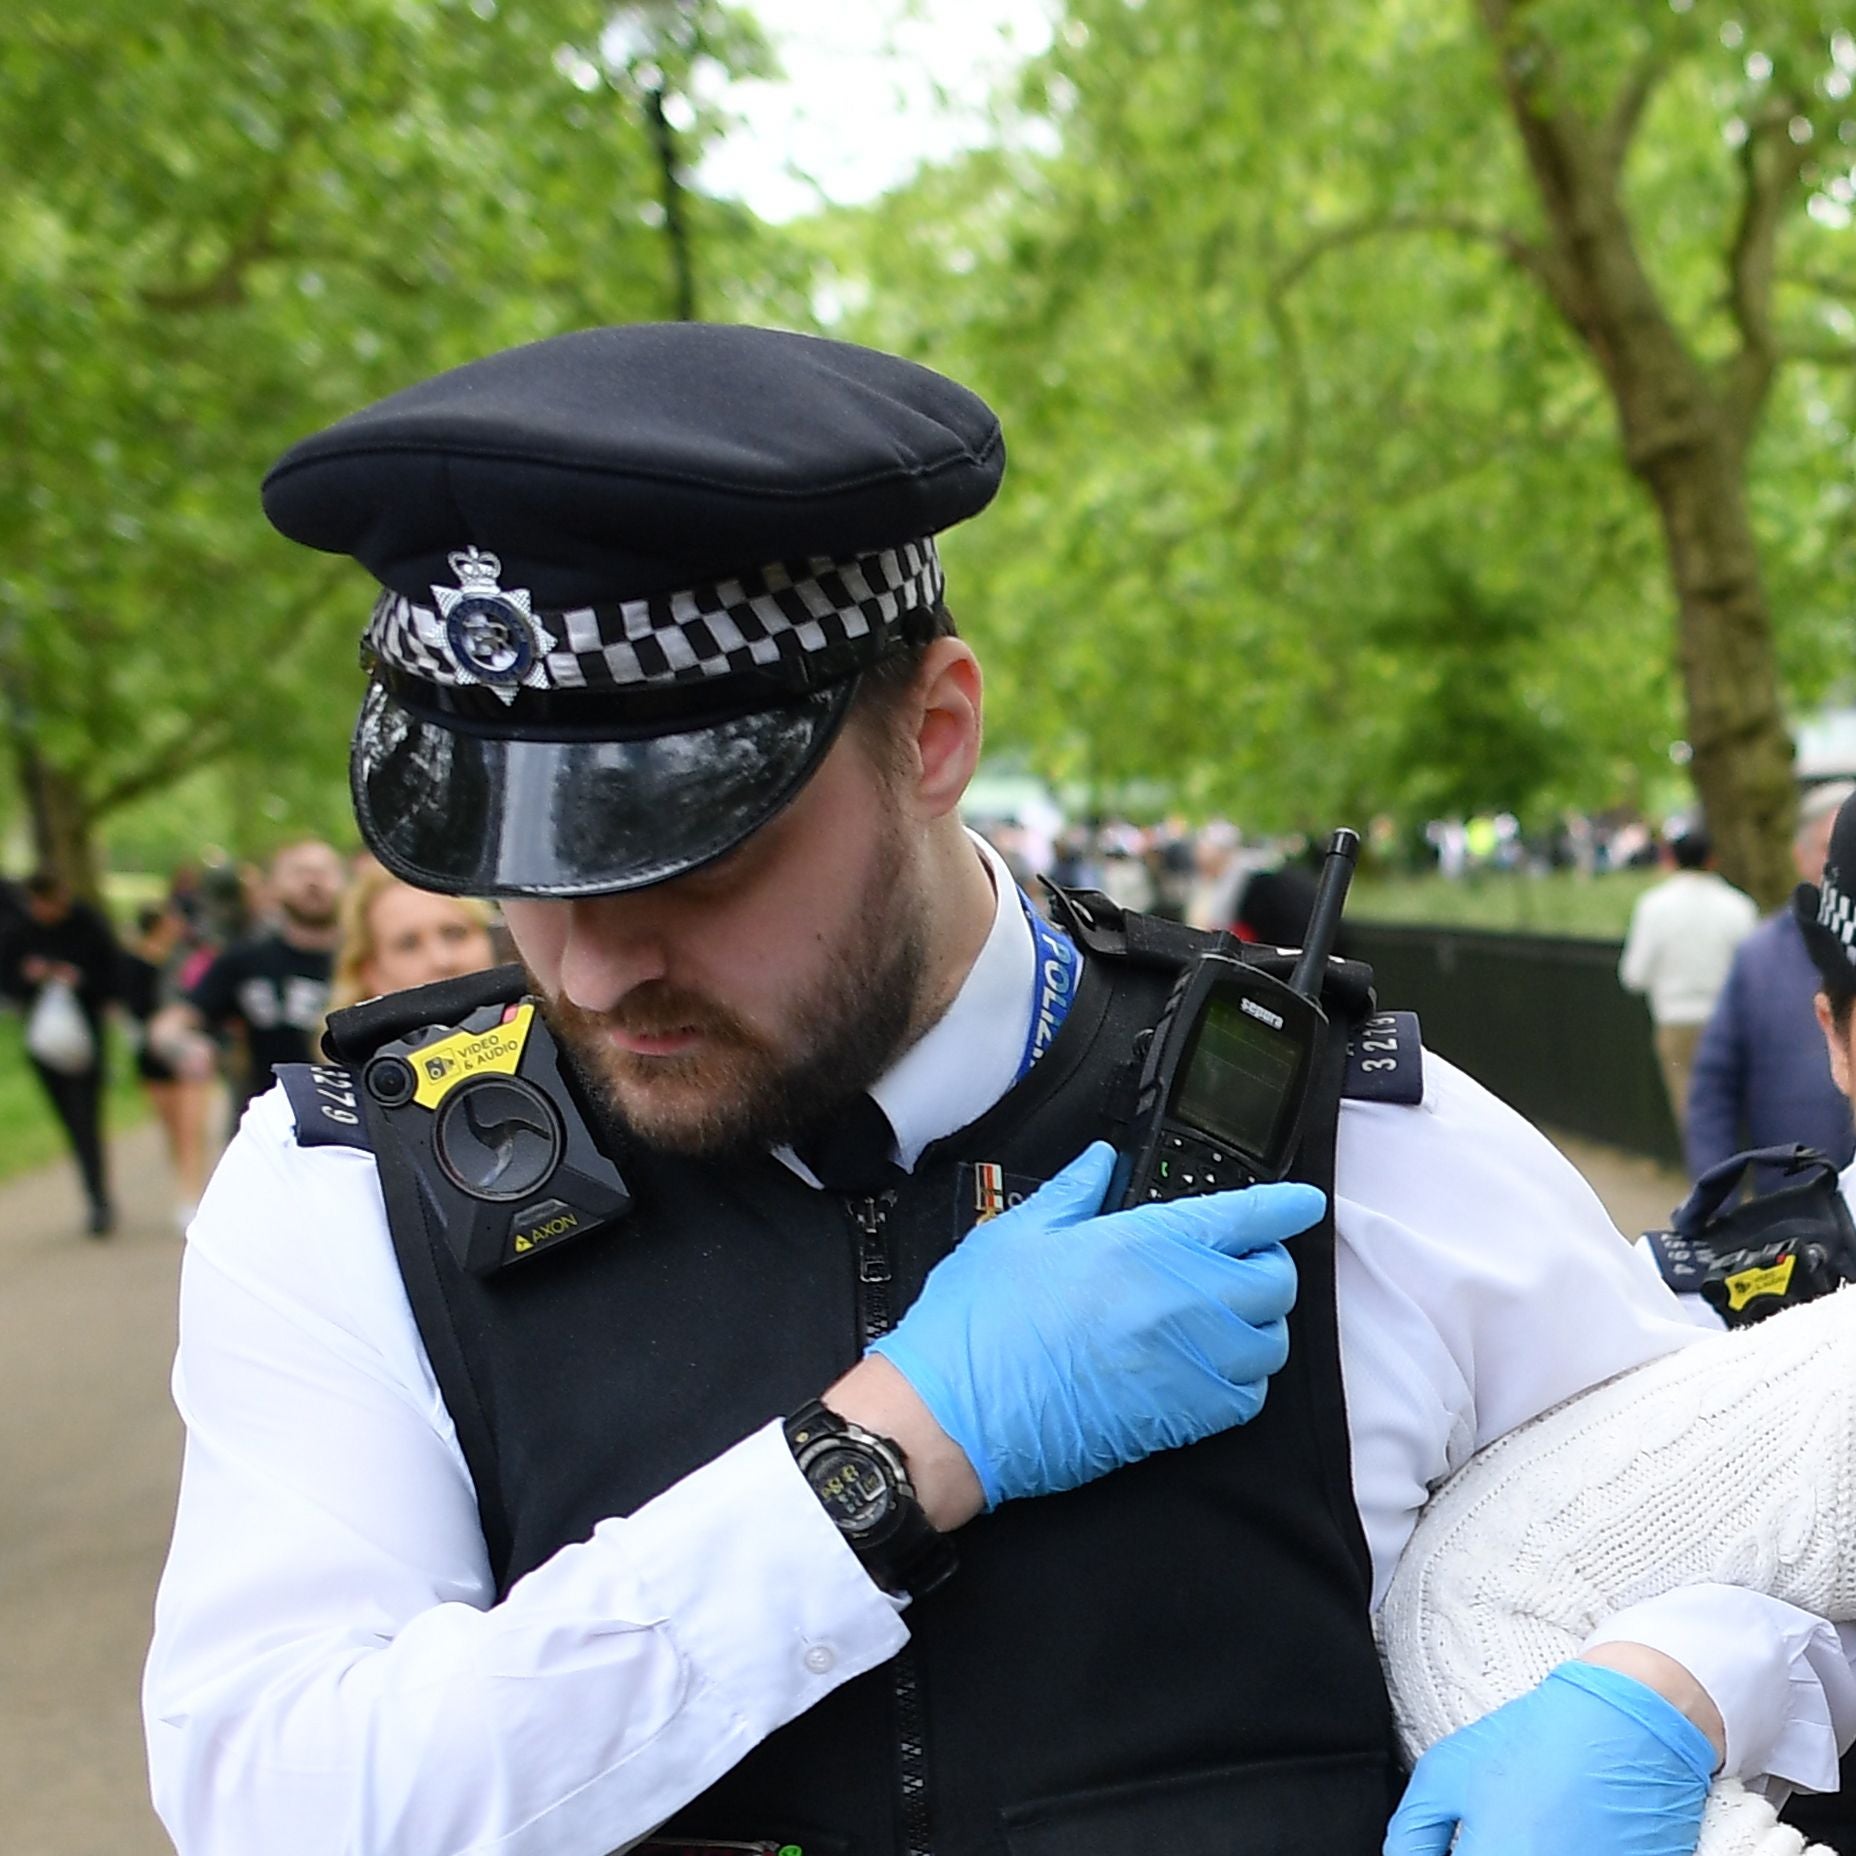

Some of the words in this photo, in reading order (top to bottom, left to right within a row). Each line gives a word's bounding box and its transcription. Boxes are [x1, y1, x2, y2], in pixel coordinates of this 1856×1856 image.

[1029, 933, 1071, 1068] POLIZ
[457, 1035, 499, 1058] VIDEO
[464, 1060, 474, 1070] &
[477, 1040, 518, 1065] AUDIO
[532, 1213, 578, 1244] AXON
